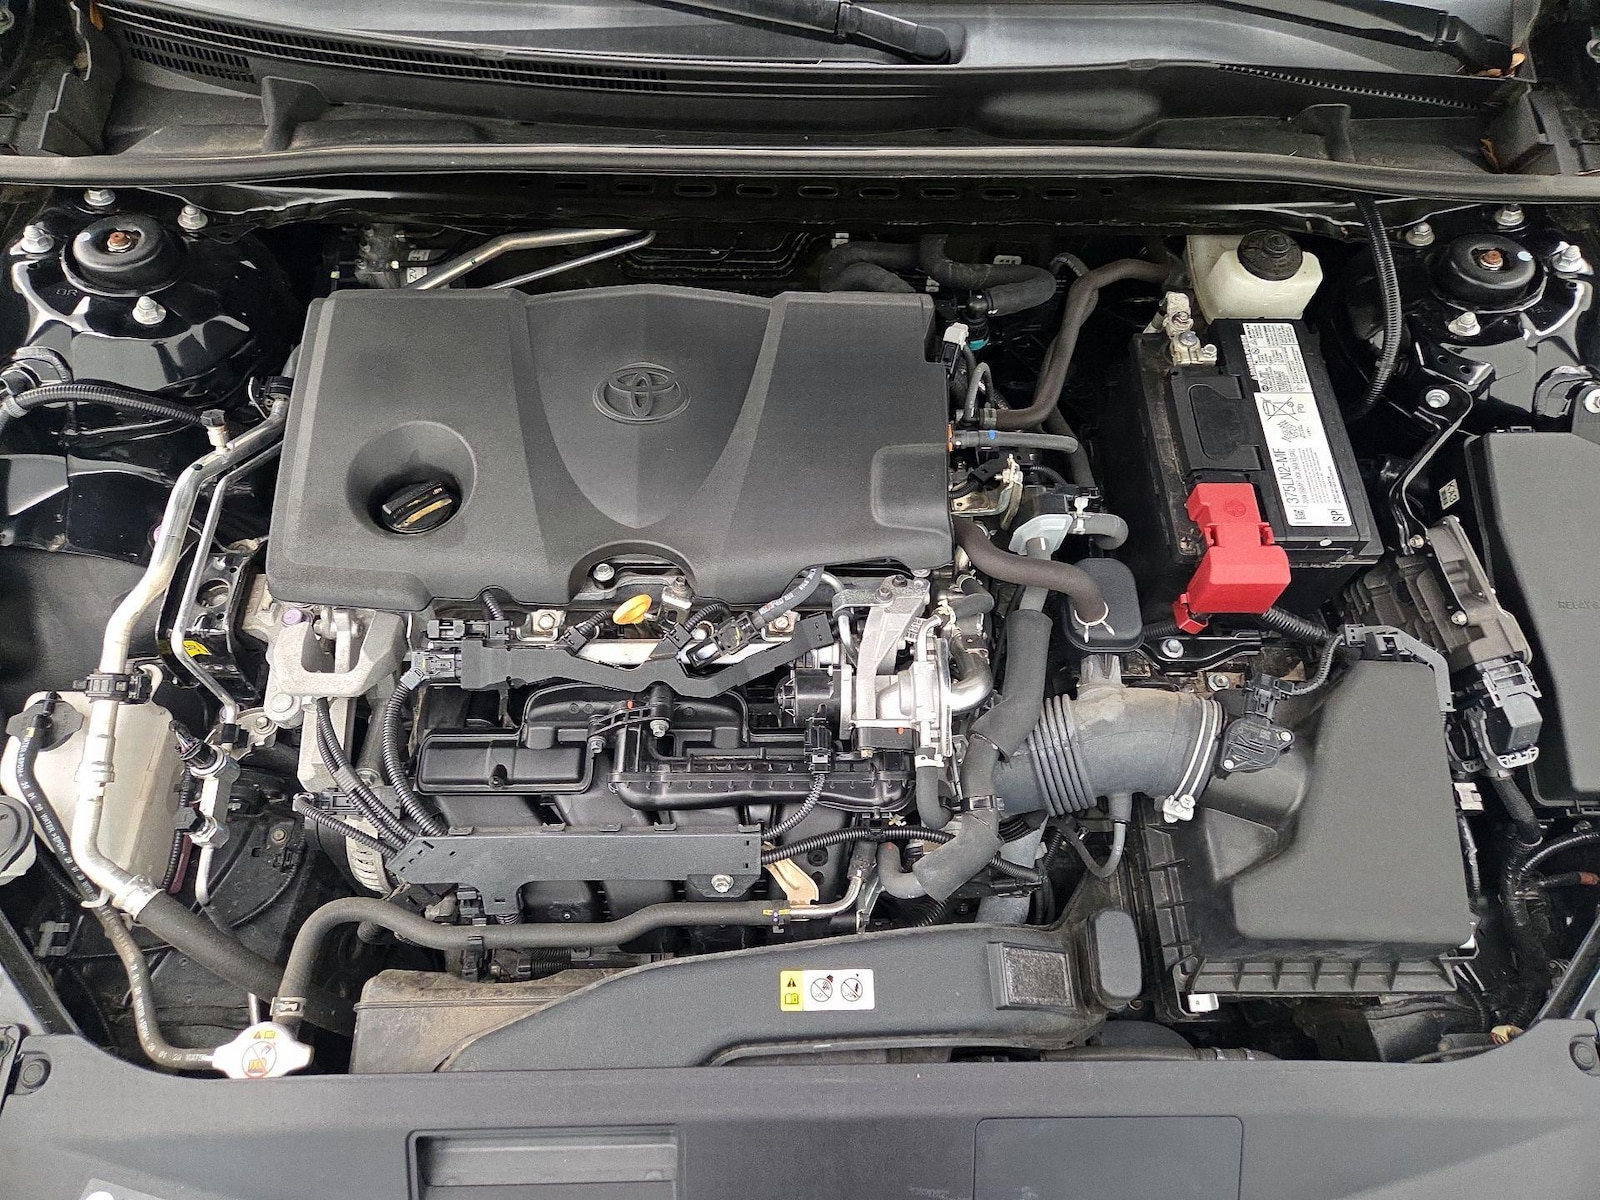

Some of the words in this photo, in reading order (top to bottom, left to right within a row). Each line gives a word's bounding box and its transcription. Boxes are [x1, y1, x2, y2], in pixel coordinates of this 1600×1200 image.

[1273, 447, 1300, 504] 375LN2-MF
[1330, 509, 1345, 522] SP
[40, 812, 56, 834] WATER
